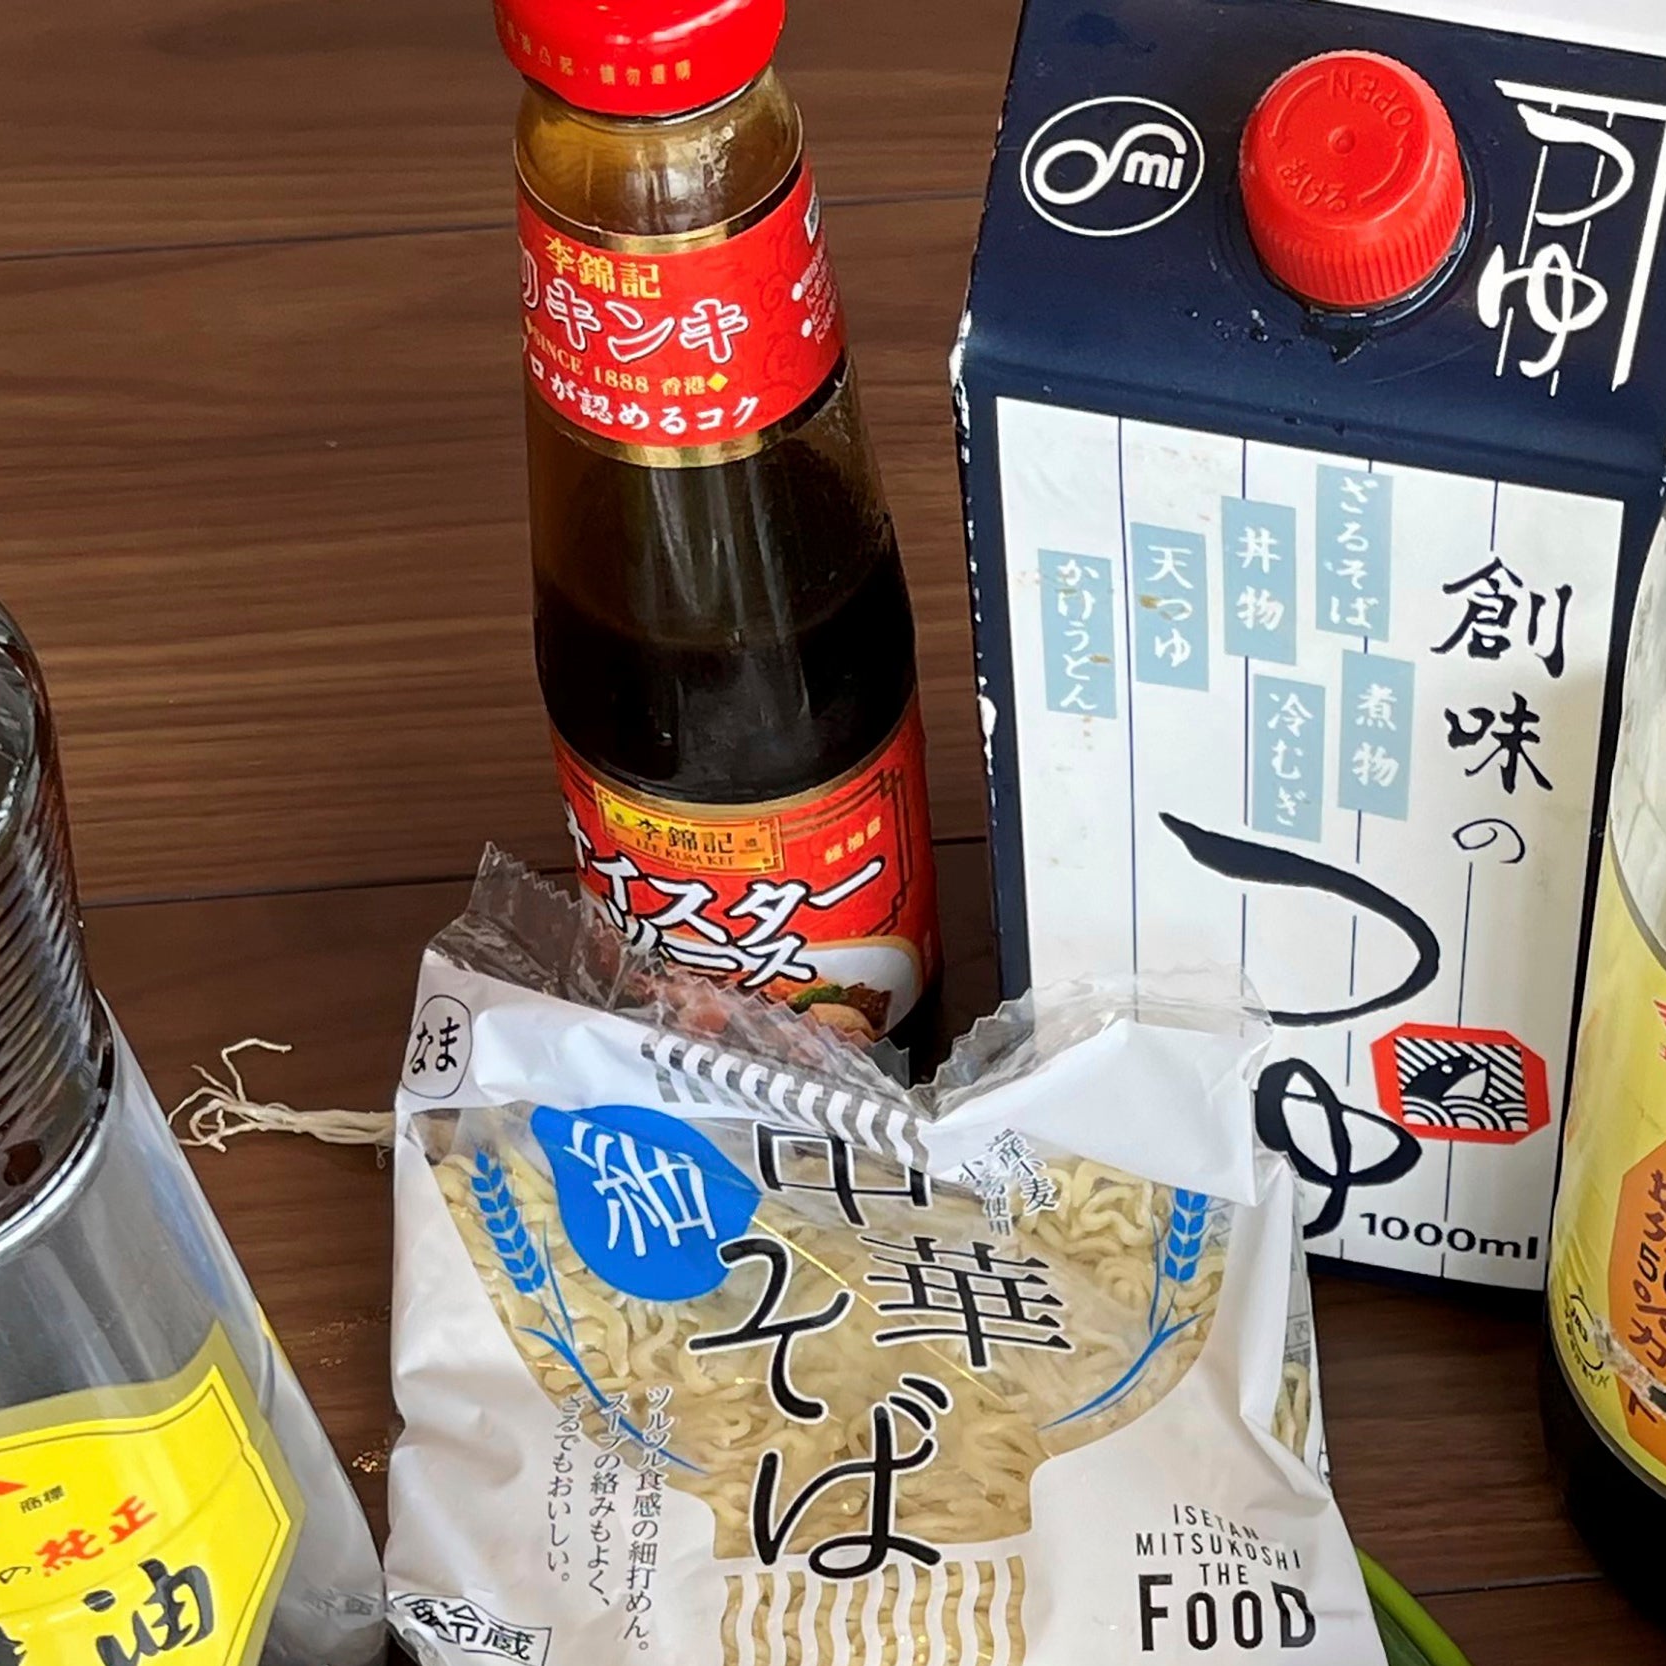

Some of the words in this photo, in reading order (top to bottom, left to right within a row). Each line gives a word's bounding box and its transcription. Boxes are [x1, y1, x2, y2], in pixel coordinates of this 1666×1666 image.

[545, 235, 662, 299] 李錦記
[1477, 104, 1635, 378] つゆ
[523, 336, 759, 436] ロが認めるコク
[593, 366, 650, 394] 1888
[660, 376, 707, 398] 香港
[1236, 527, 1286, 632] 丼物
[1328, 475, 1379, 630] ざるそば
[1055, 558, 1101, 712] かけうどん
[1148, 545, 1194, 669] 天つゆ
[1266, 692, 1313, 826] 冷むぎ
[1352, 682, 1400, 789] 煮物
[1430, 556, 1573, 864] 創味の
[636, 814, 734, 855] 李錦記
[669, 847, 706, 866] KUM
[409, 1017, 460, 1074] なま
[1158, 810, 1441, 1241] つゆ
[563, 1120, 717, 1258] 細
[1359, 1211, 1538, 1262] 1000ml
[20, 1486, 65, 1513] 商標
[547, 1393, 587, 1582] ざるでもおいしい。
[588, 1393, 631, 1606] スープの絡みもよく、
[623, 1386, 672, 1651] ツルツル食感の細打めん。
[1173, 1504, 1259, 1541] ISETAN
[1136, 1533, 1301, 1571] MITSUKOSHI
[1199, 1563, 1250, 1586] THE
[1138, 1573, 1316, 1652] FOOD
